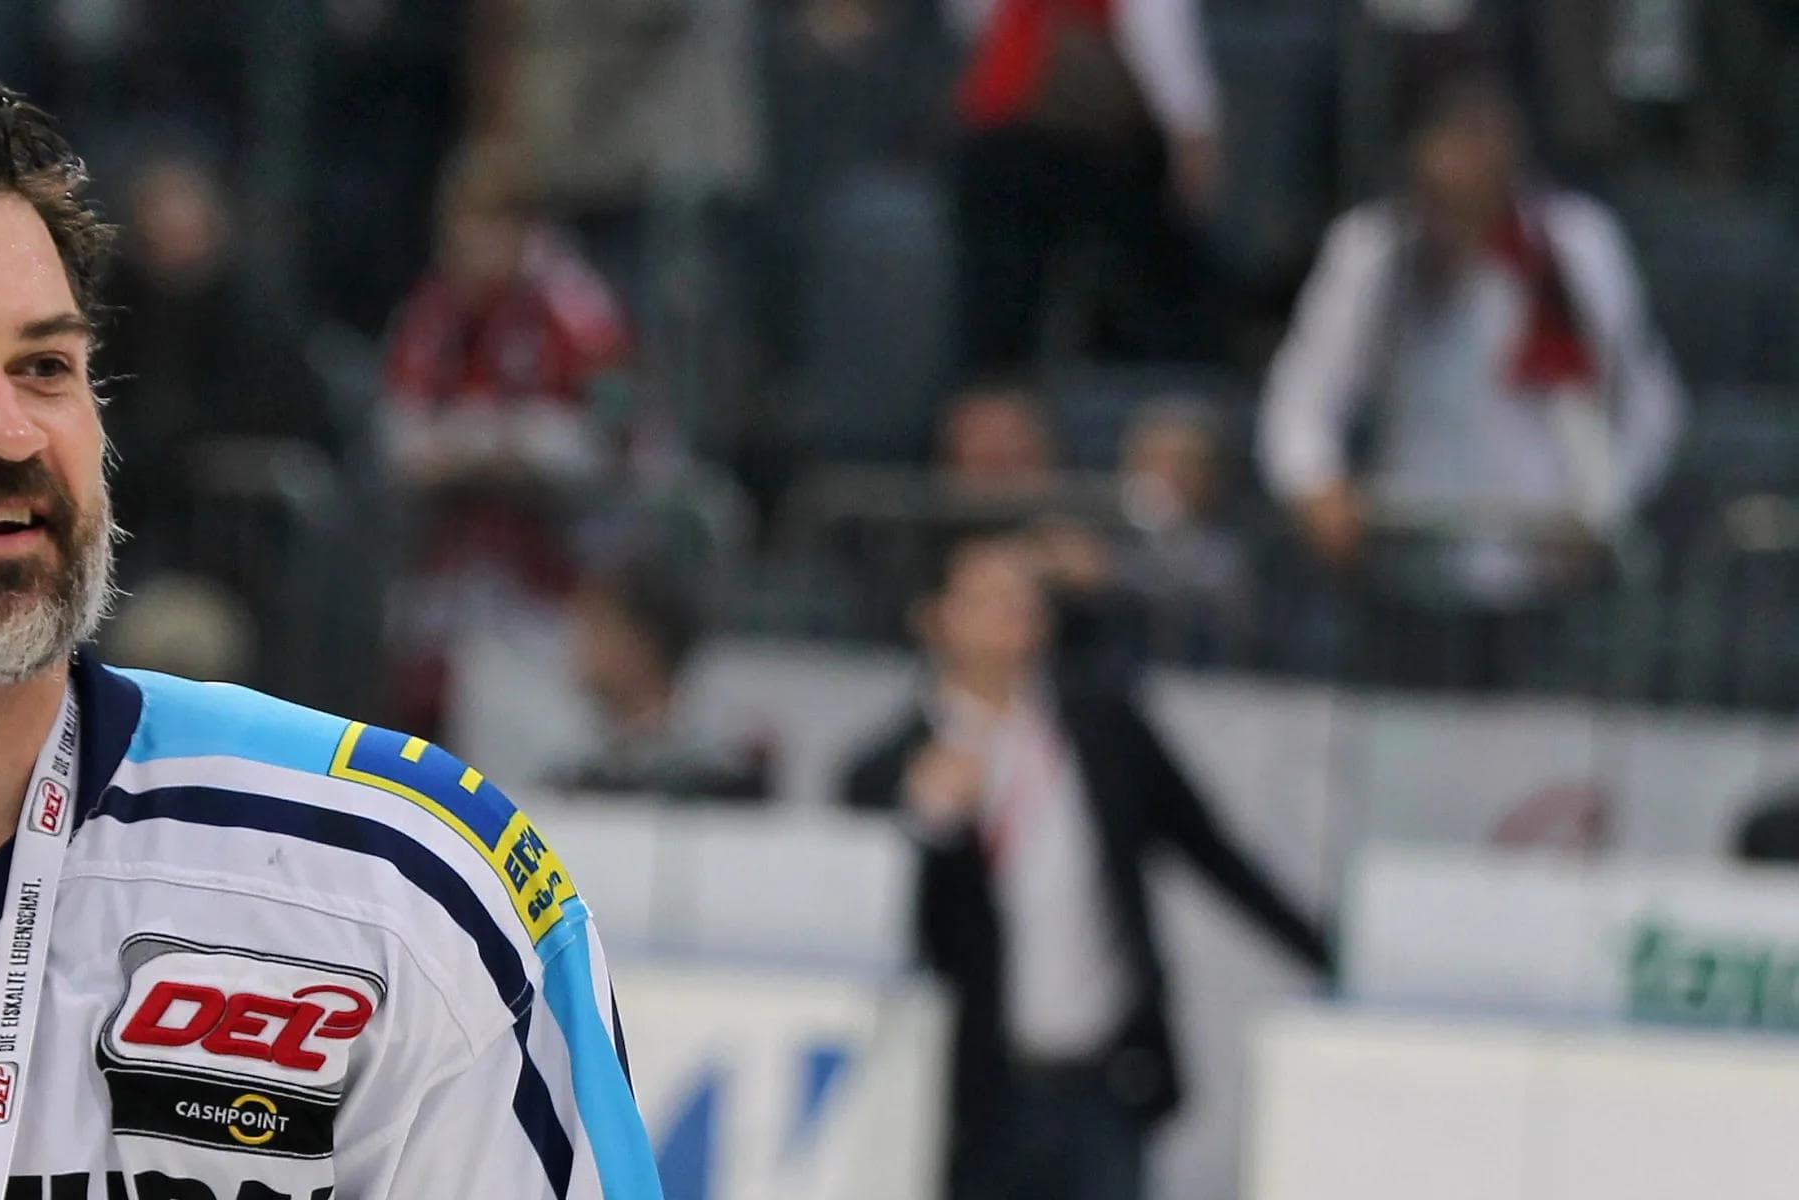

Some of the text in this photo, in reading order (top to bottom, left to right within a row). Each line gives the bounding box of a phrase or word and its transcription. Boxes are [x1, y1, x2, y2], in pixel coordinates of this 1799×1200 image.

[51, 755, 70, 777] DIE
[9, 877, 42, 967] LEIDENSCHAFT.
[1, 969, 27, 1028] EISKALTE
[120, 981, 372, 1072] DEL
[175, 1101, 289, 1132] CASHPOINT
